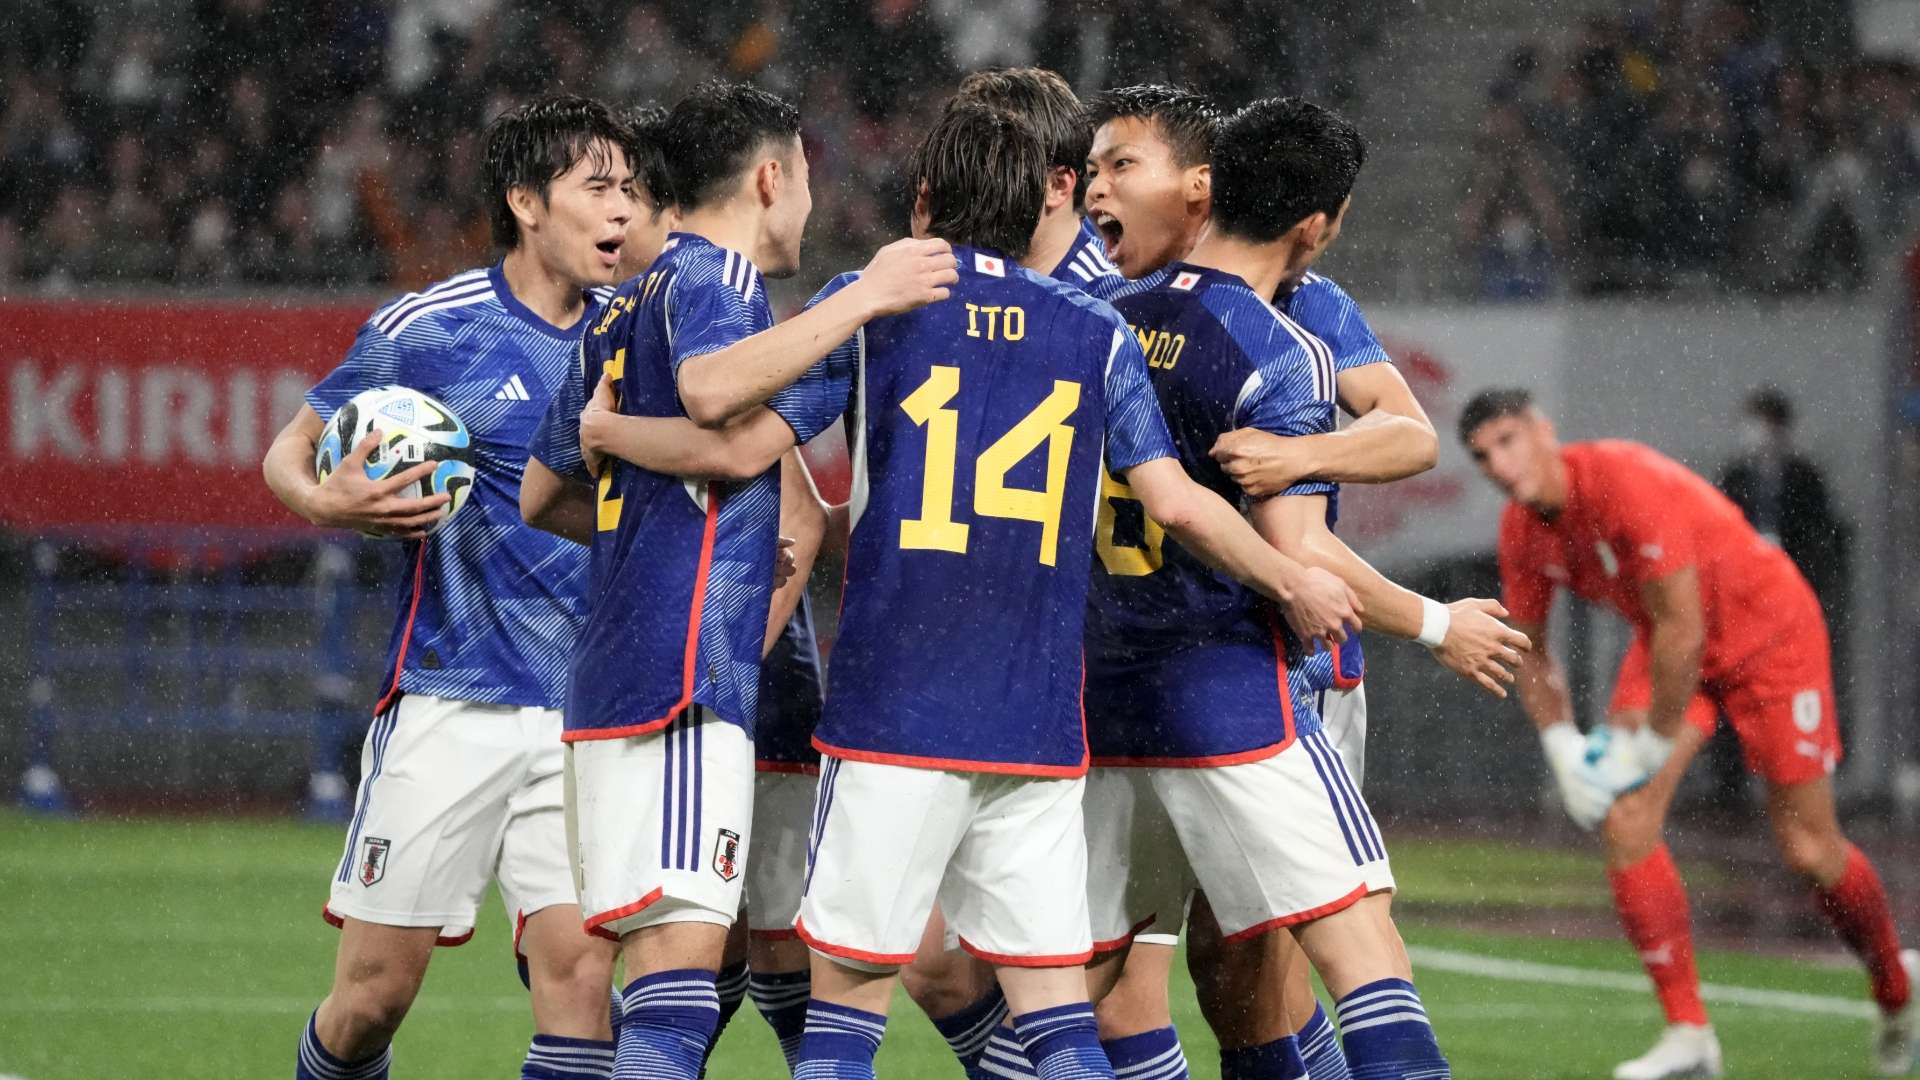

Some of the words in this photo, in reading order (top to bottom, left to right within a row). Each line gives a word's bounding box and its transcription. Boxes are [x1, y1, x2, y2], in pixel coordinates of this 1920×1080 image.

[966, 303, 1025, 341] ITO
[1127, 324, 1186, 370] NDO
[899, 365, 1081, 567] 14
